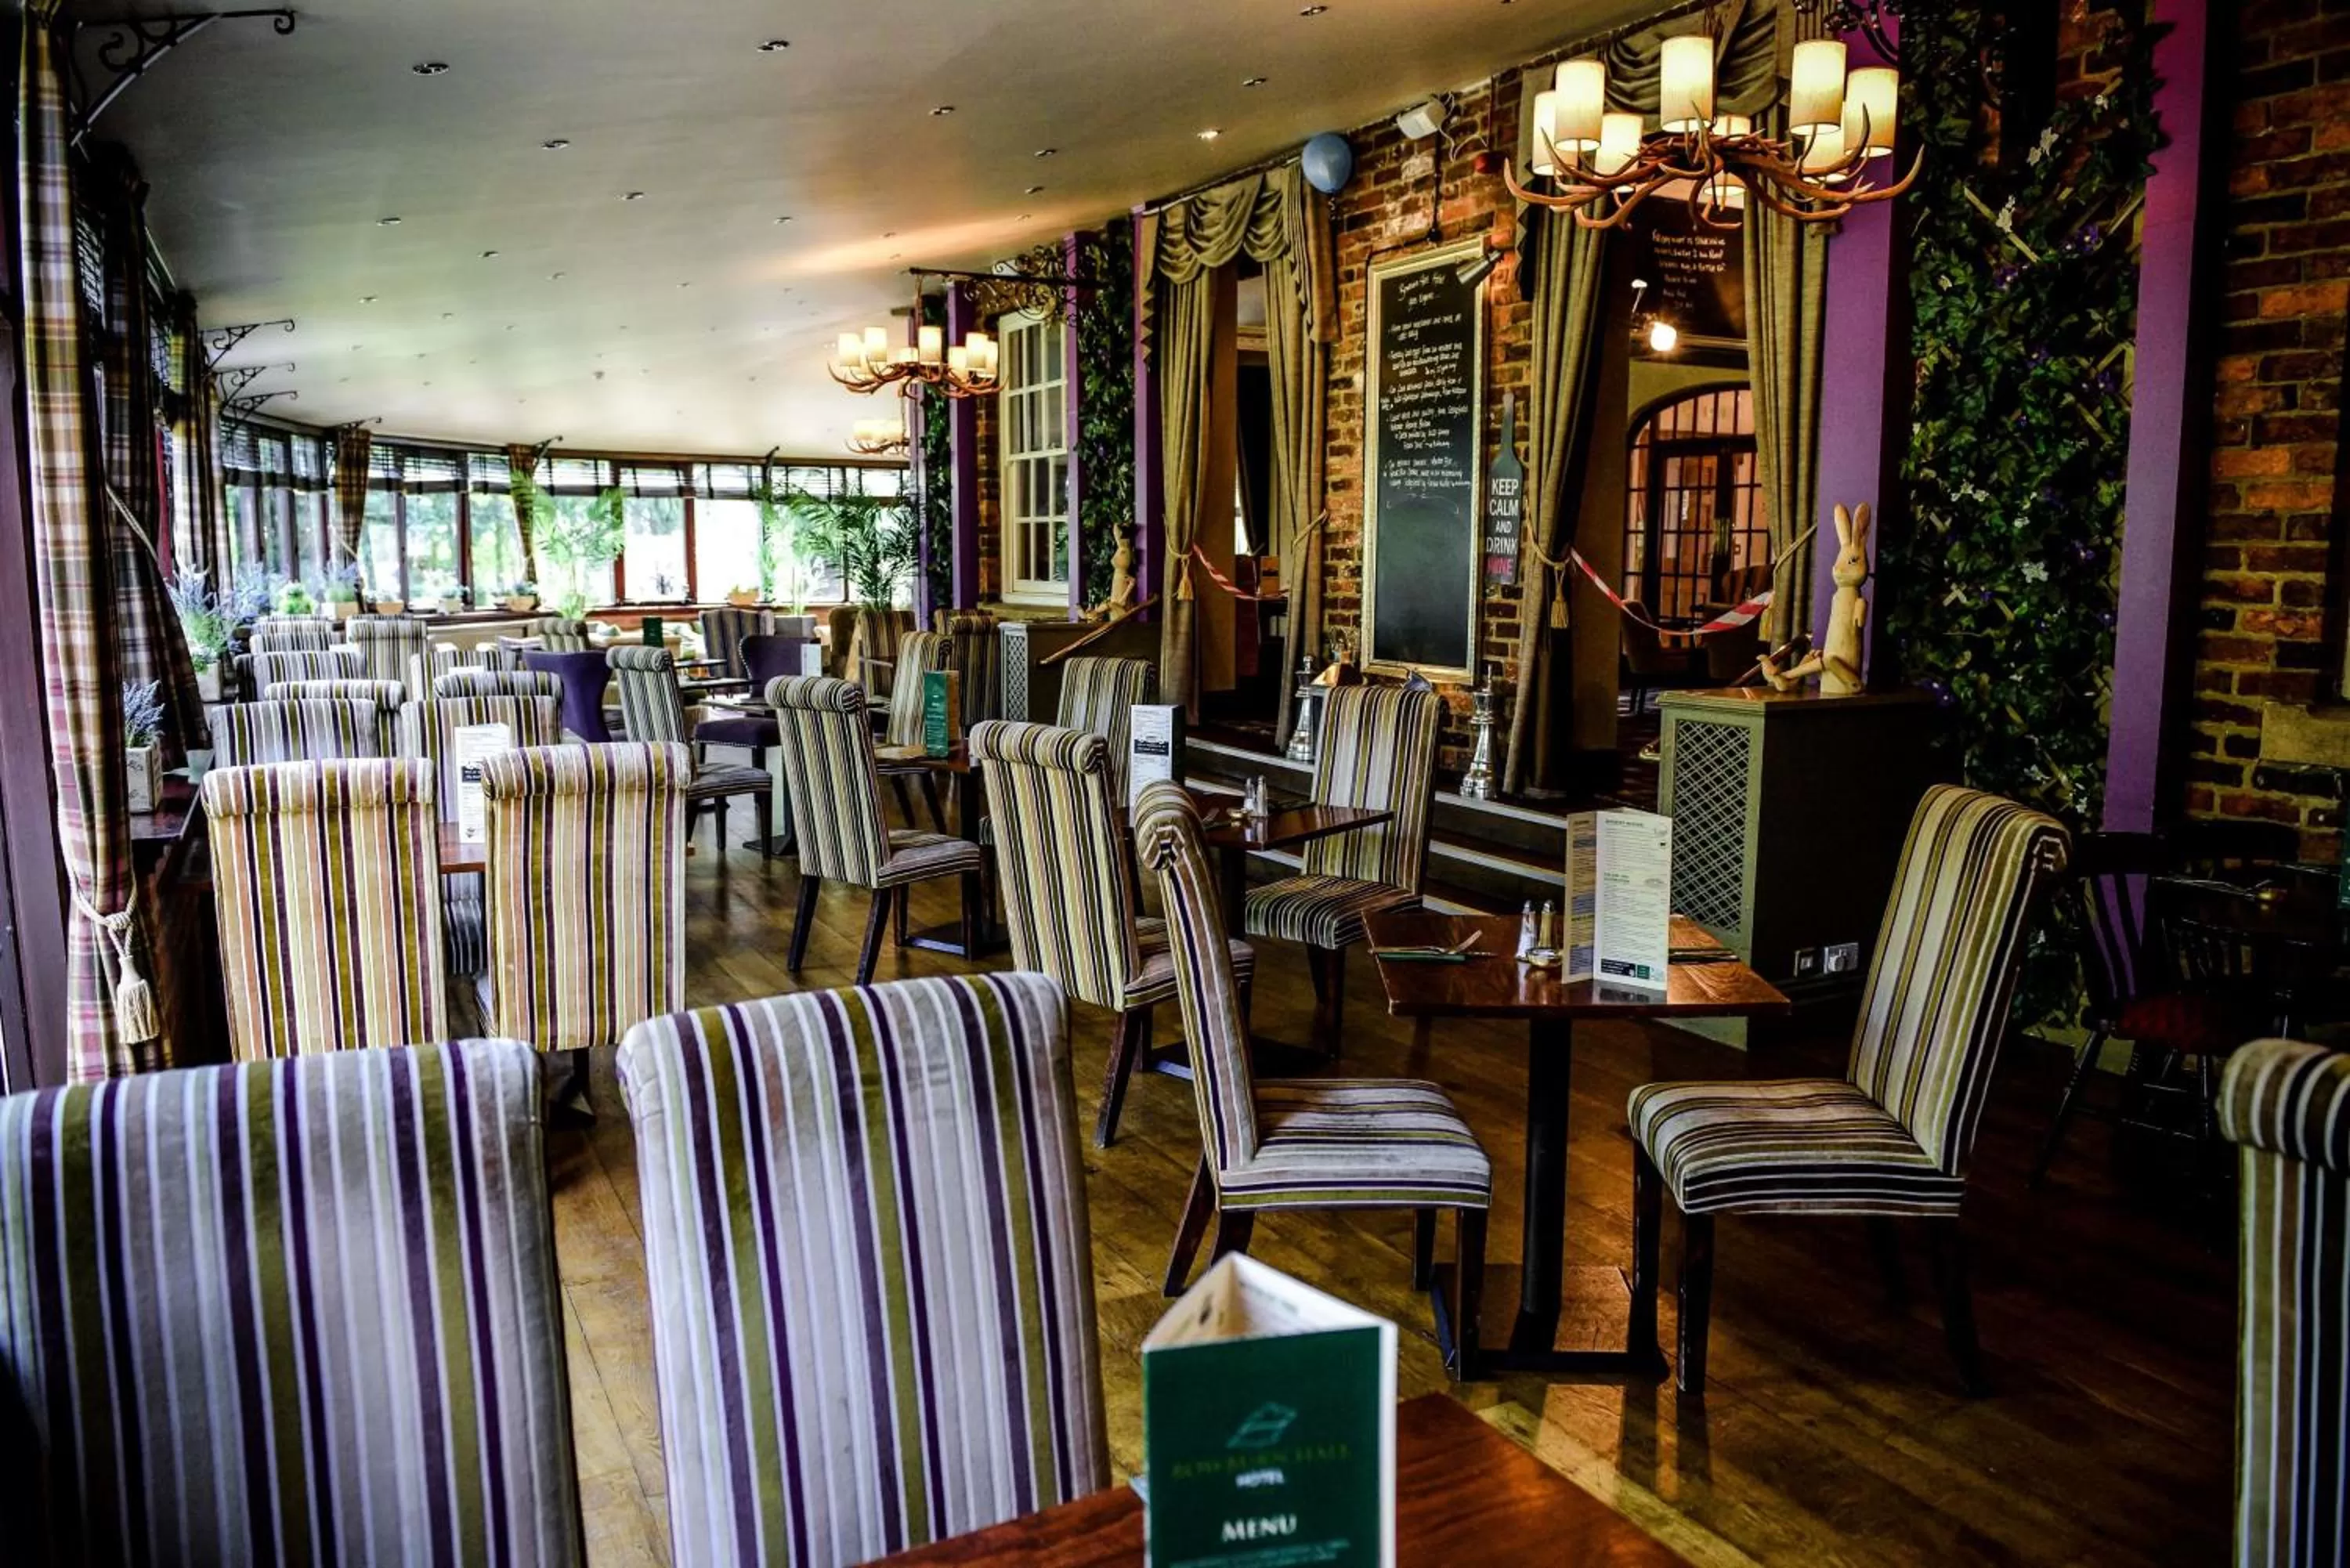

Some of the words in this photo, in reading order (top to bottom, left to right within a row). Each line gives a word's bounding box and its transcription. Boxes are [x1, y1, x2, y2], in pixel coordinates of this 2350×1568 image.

[1491, 479, 1519, 496] KEEP
[1489, 499, 1519, 517] CALM
[1495, 520, 1513, 533] AND
[1486, 537, 1518, 555] DRINK
[1221, 1513, 1297, 1542] MENU
